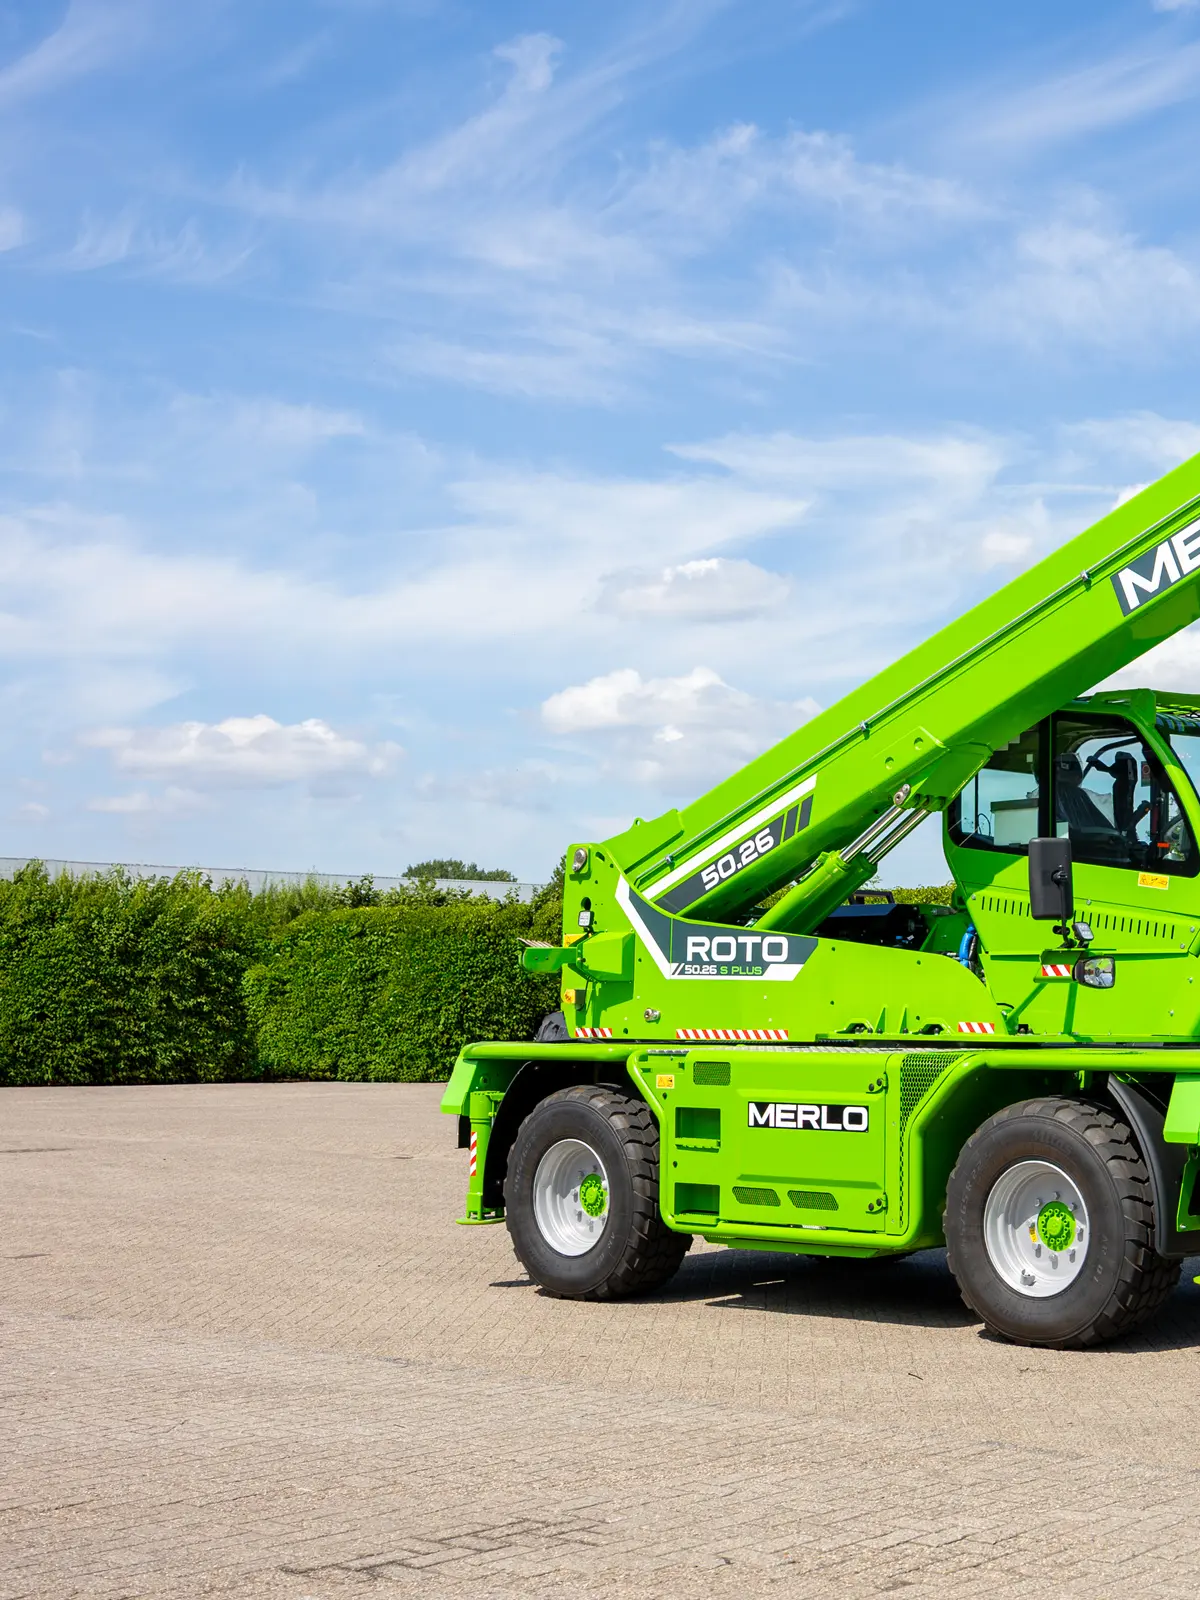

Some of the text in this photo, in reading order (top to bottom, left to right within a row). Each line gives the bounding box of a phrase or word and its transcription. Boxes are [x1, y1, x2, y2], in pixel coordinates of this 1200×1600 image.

[701, 828, 774, 891] 50.26
[687, 936, 788, 962] ROTO
[685, 965, 762, 975] 50.26 S PLUS
[749, 1103, 868, 1131] MERLO
